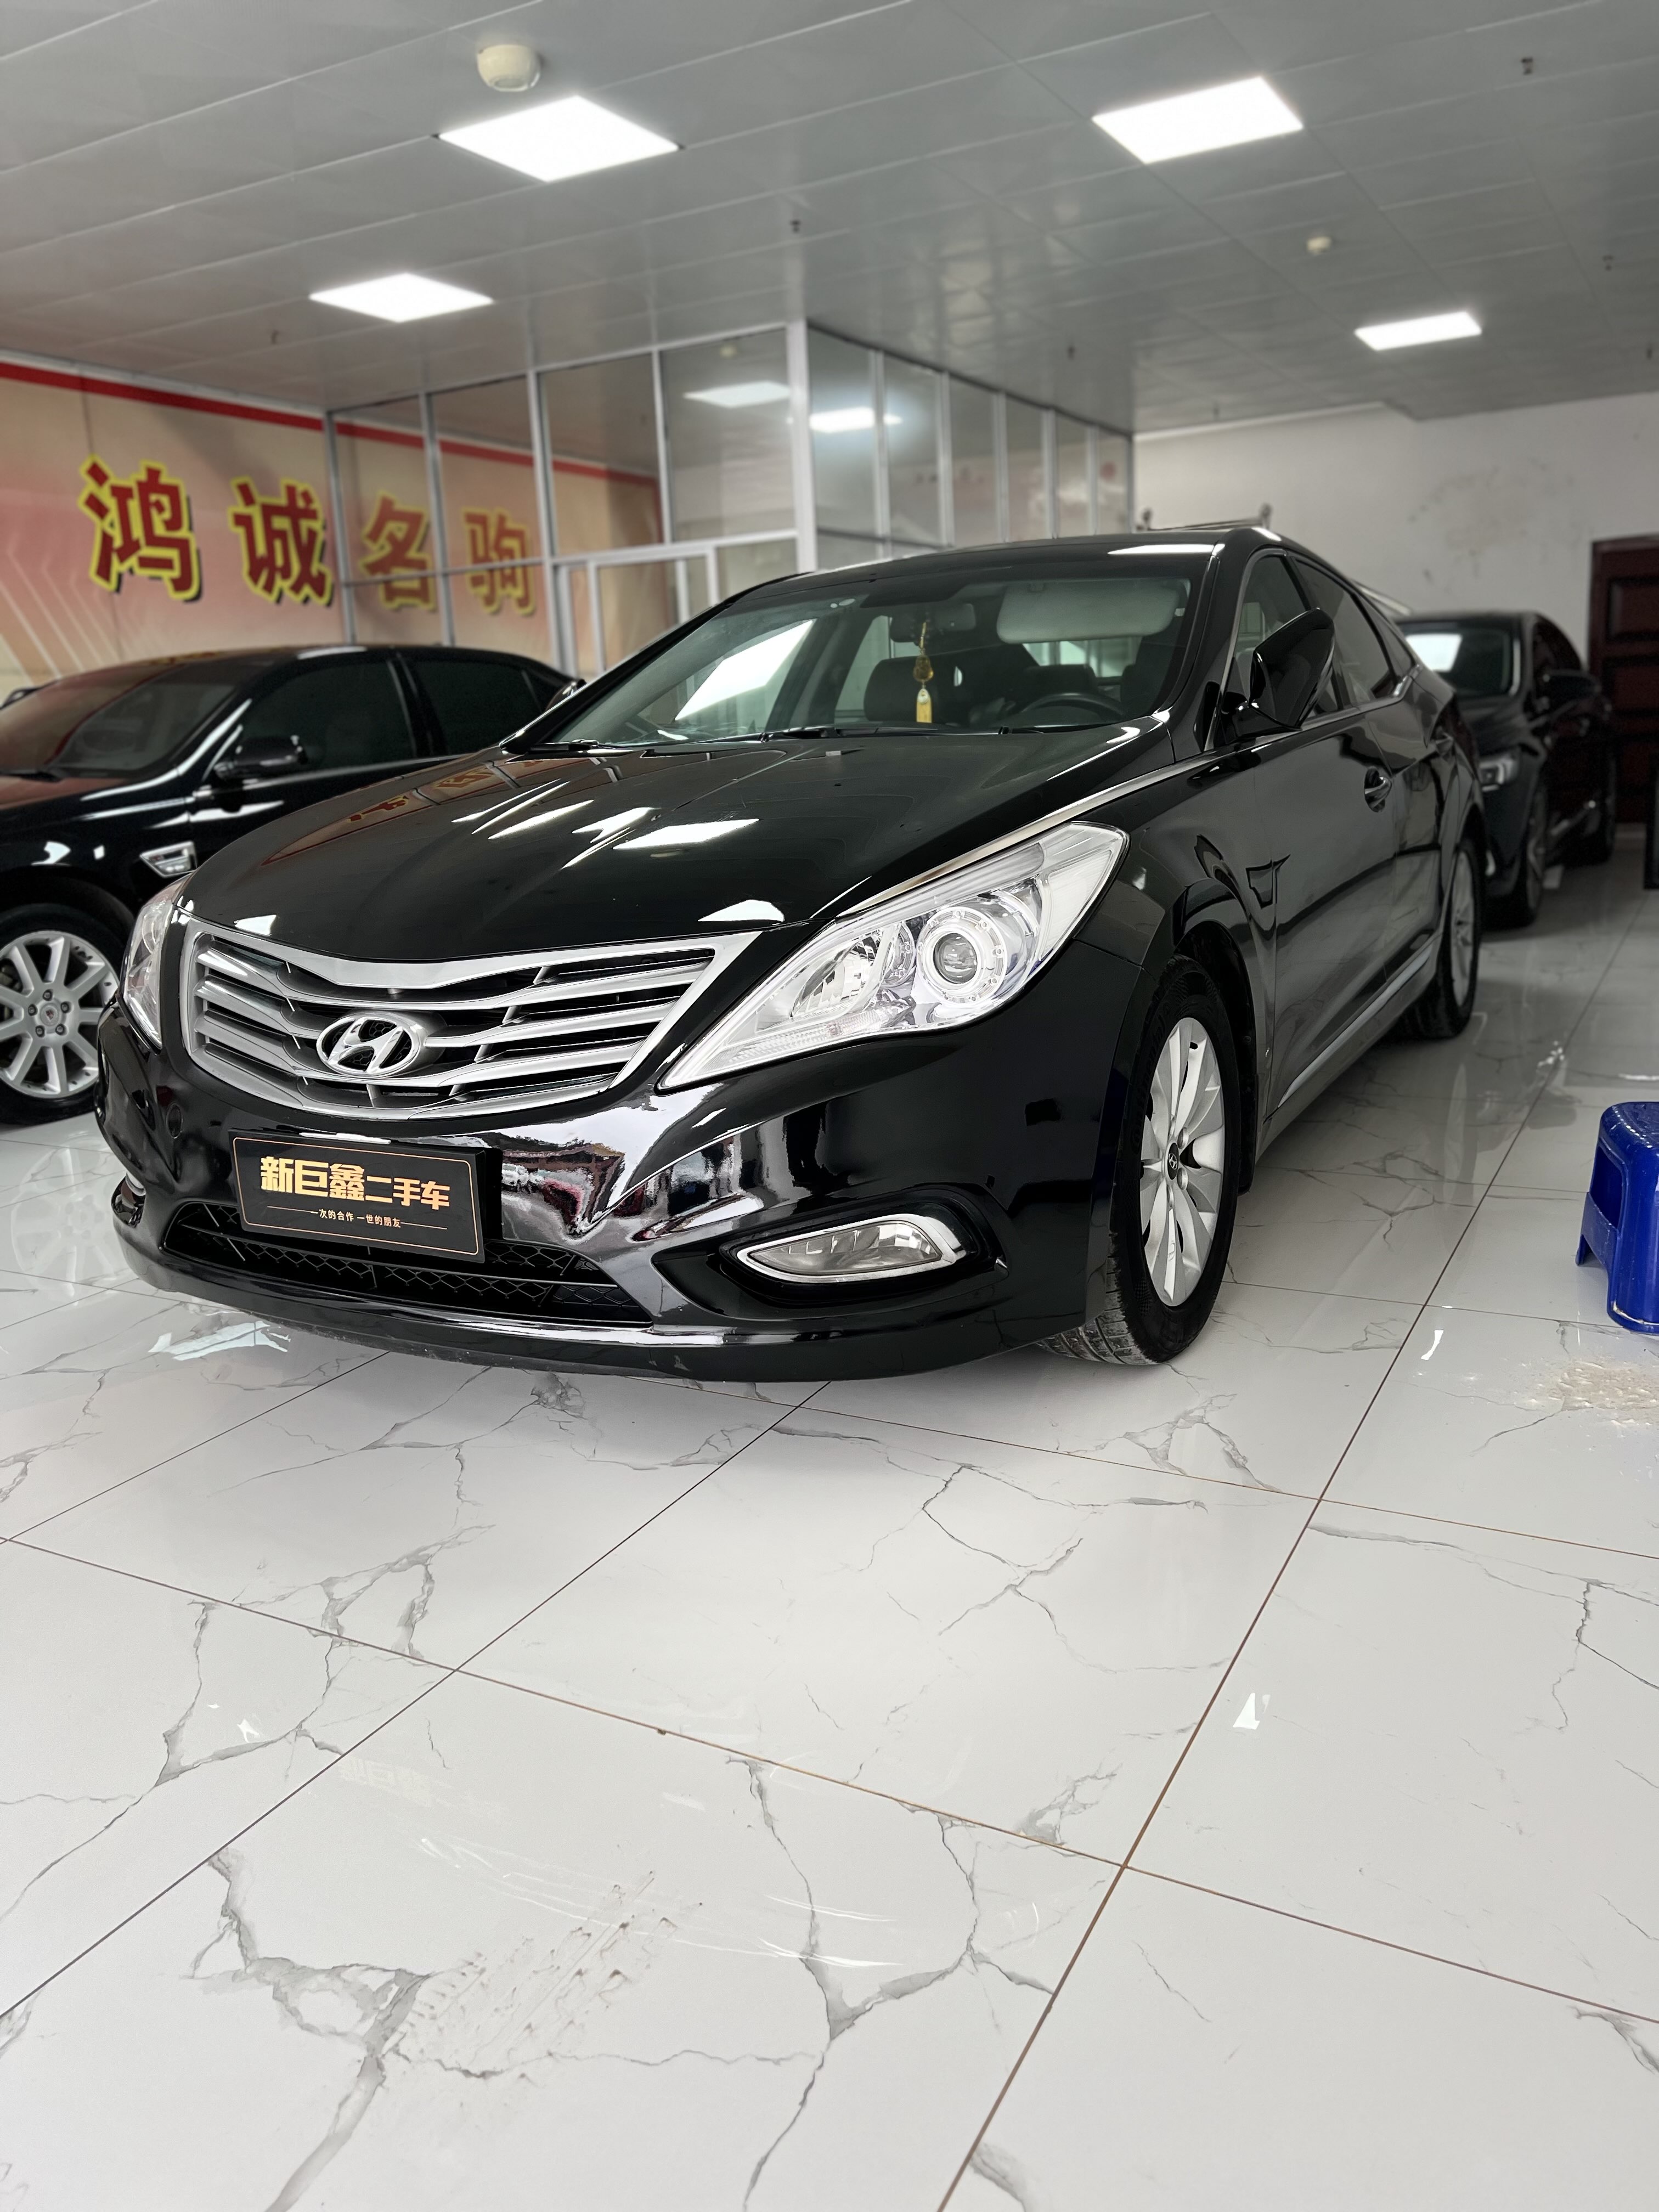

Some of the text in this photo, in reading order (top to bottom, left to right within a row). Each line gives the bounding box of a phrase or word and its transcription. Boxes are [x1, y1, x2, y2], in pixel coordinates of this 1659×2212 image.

[78, 455, 537, 616] 鸿诚名驹
[261, 1156, 450, 1210] 新巨鑫二手车
[310, 1209, 401, 1228] 一次的合作 一世的朋友
